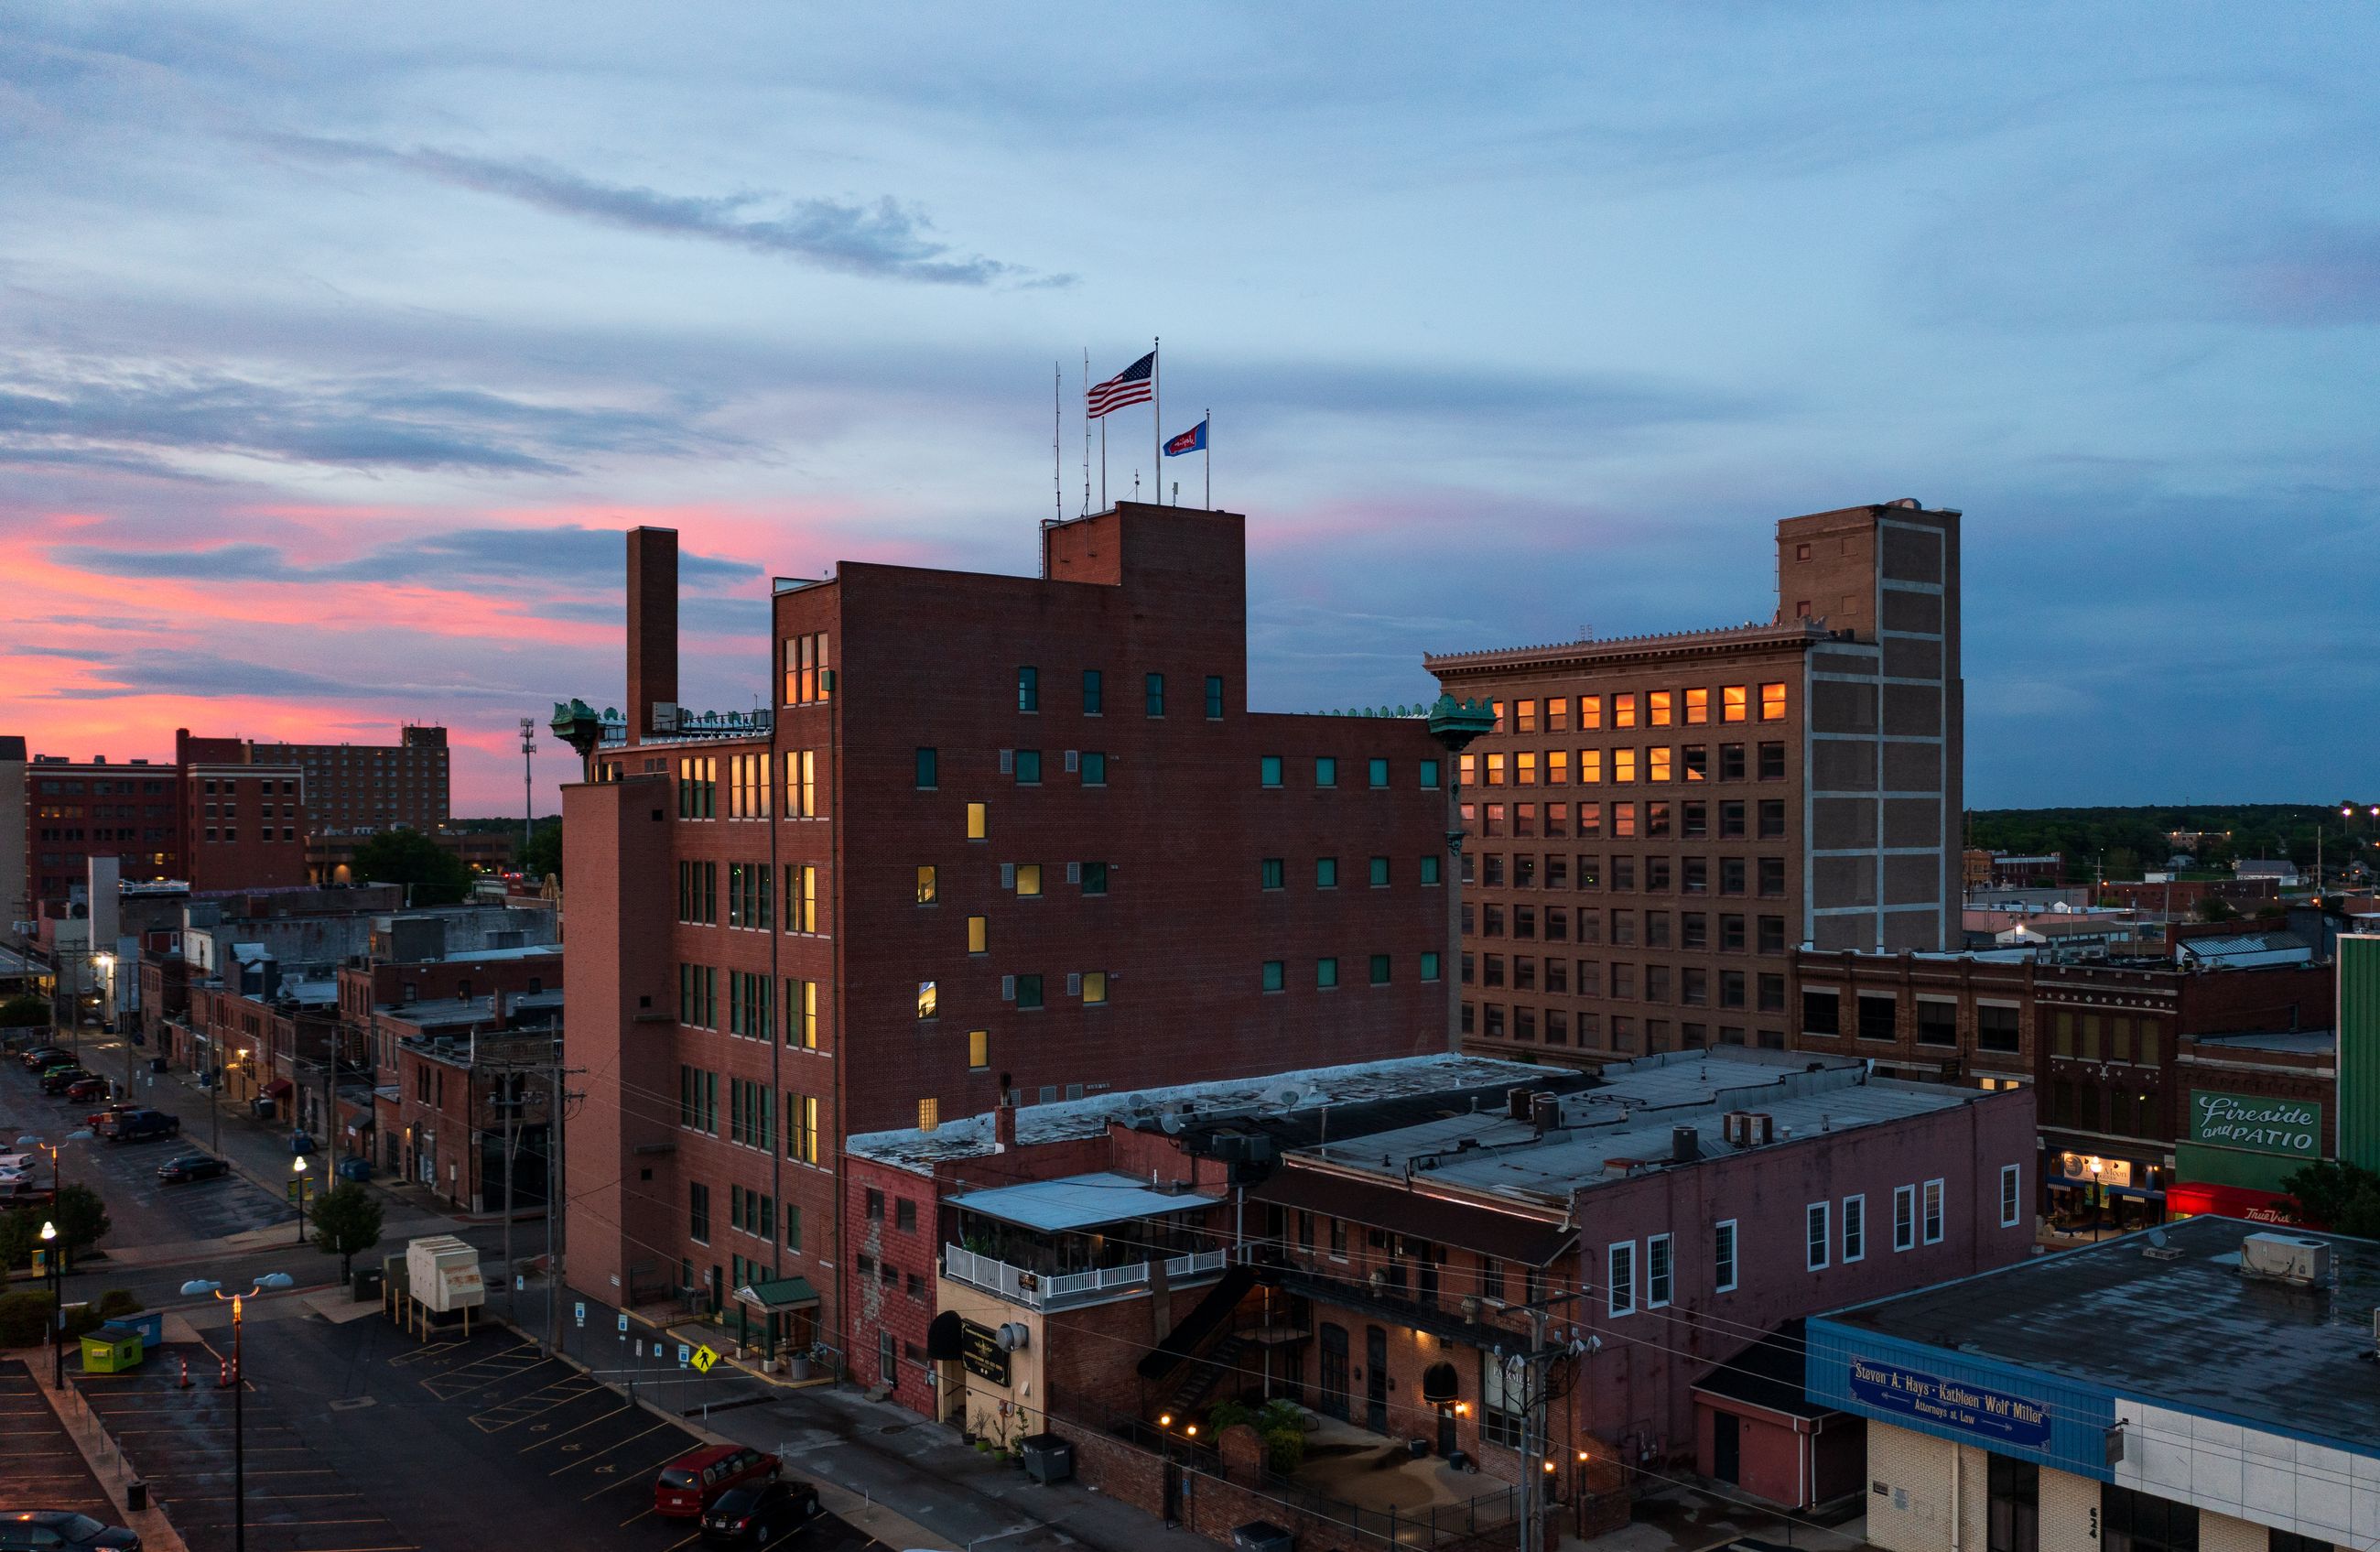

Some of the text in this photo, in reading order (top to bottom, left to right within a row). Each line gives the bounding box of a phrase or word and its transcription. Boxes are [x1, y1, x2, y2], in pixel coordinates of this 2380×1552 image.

[2199, 1096, 2313, 1127] Fireside
[2202, 1124, 2313, 1149] and PATIO
[1855, 1362, 2043, 1424] Steven A. Hays Kathleen Wolf Miller
[1914, 1398, 1975, 1425] Attorneys at Law
